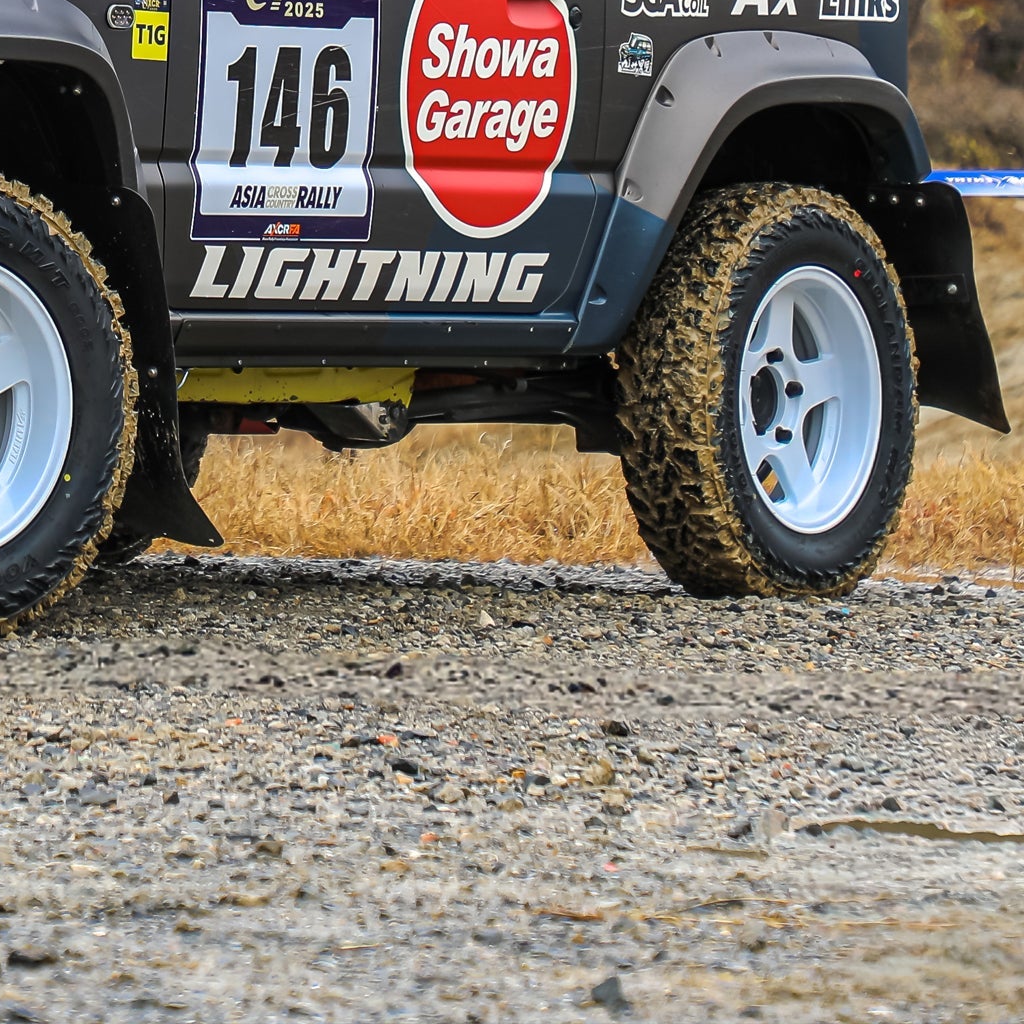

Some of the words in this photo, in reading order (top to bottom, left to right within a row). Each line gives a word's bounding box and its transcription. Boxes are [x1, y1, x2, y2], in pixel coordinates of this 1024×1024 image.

[136, 24, 166, 45] T1G
[284, 1, 324, 19] 2025
[421, 22, 560, 80] Showa
[226, 44, 352, 170] 146
[416, 89, 559, 153] Garage
[229, 185, 266, 208] ASIA
[267, 186, 298, 198] CROSS
[295, 185, 343, 209] RALLY
[189, 245, 550, 303] LIGHTNING
